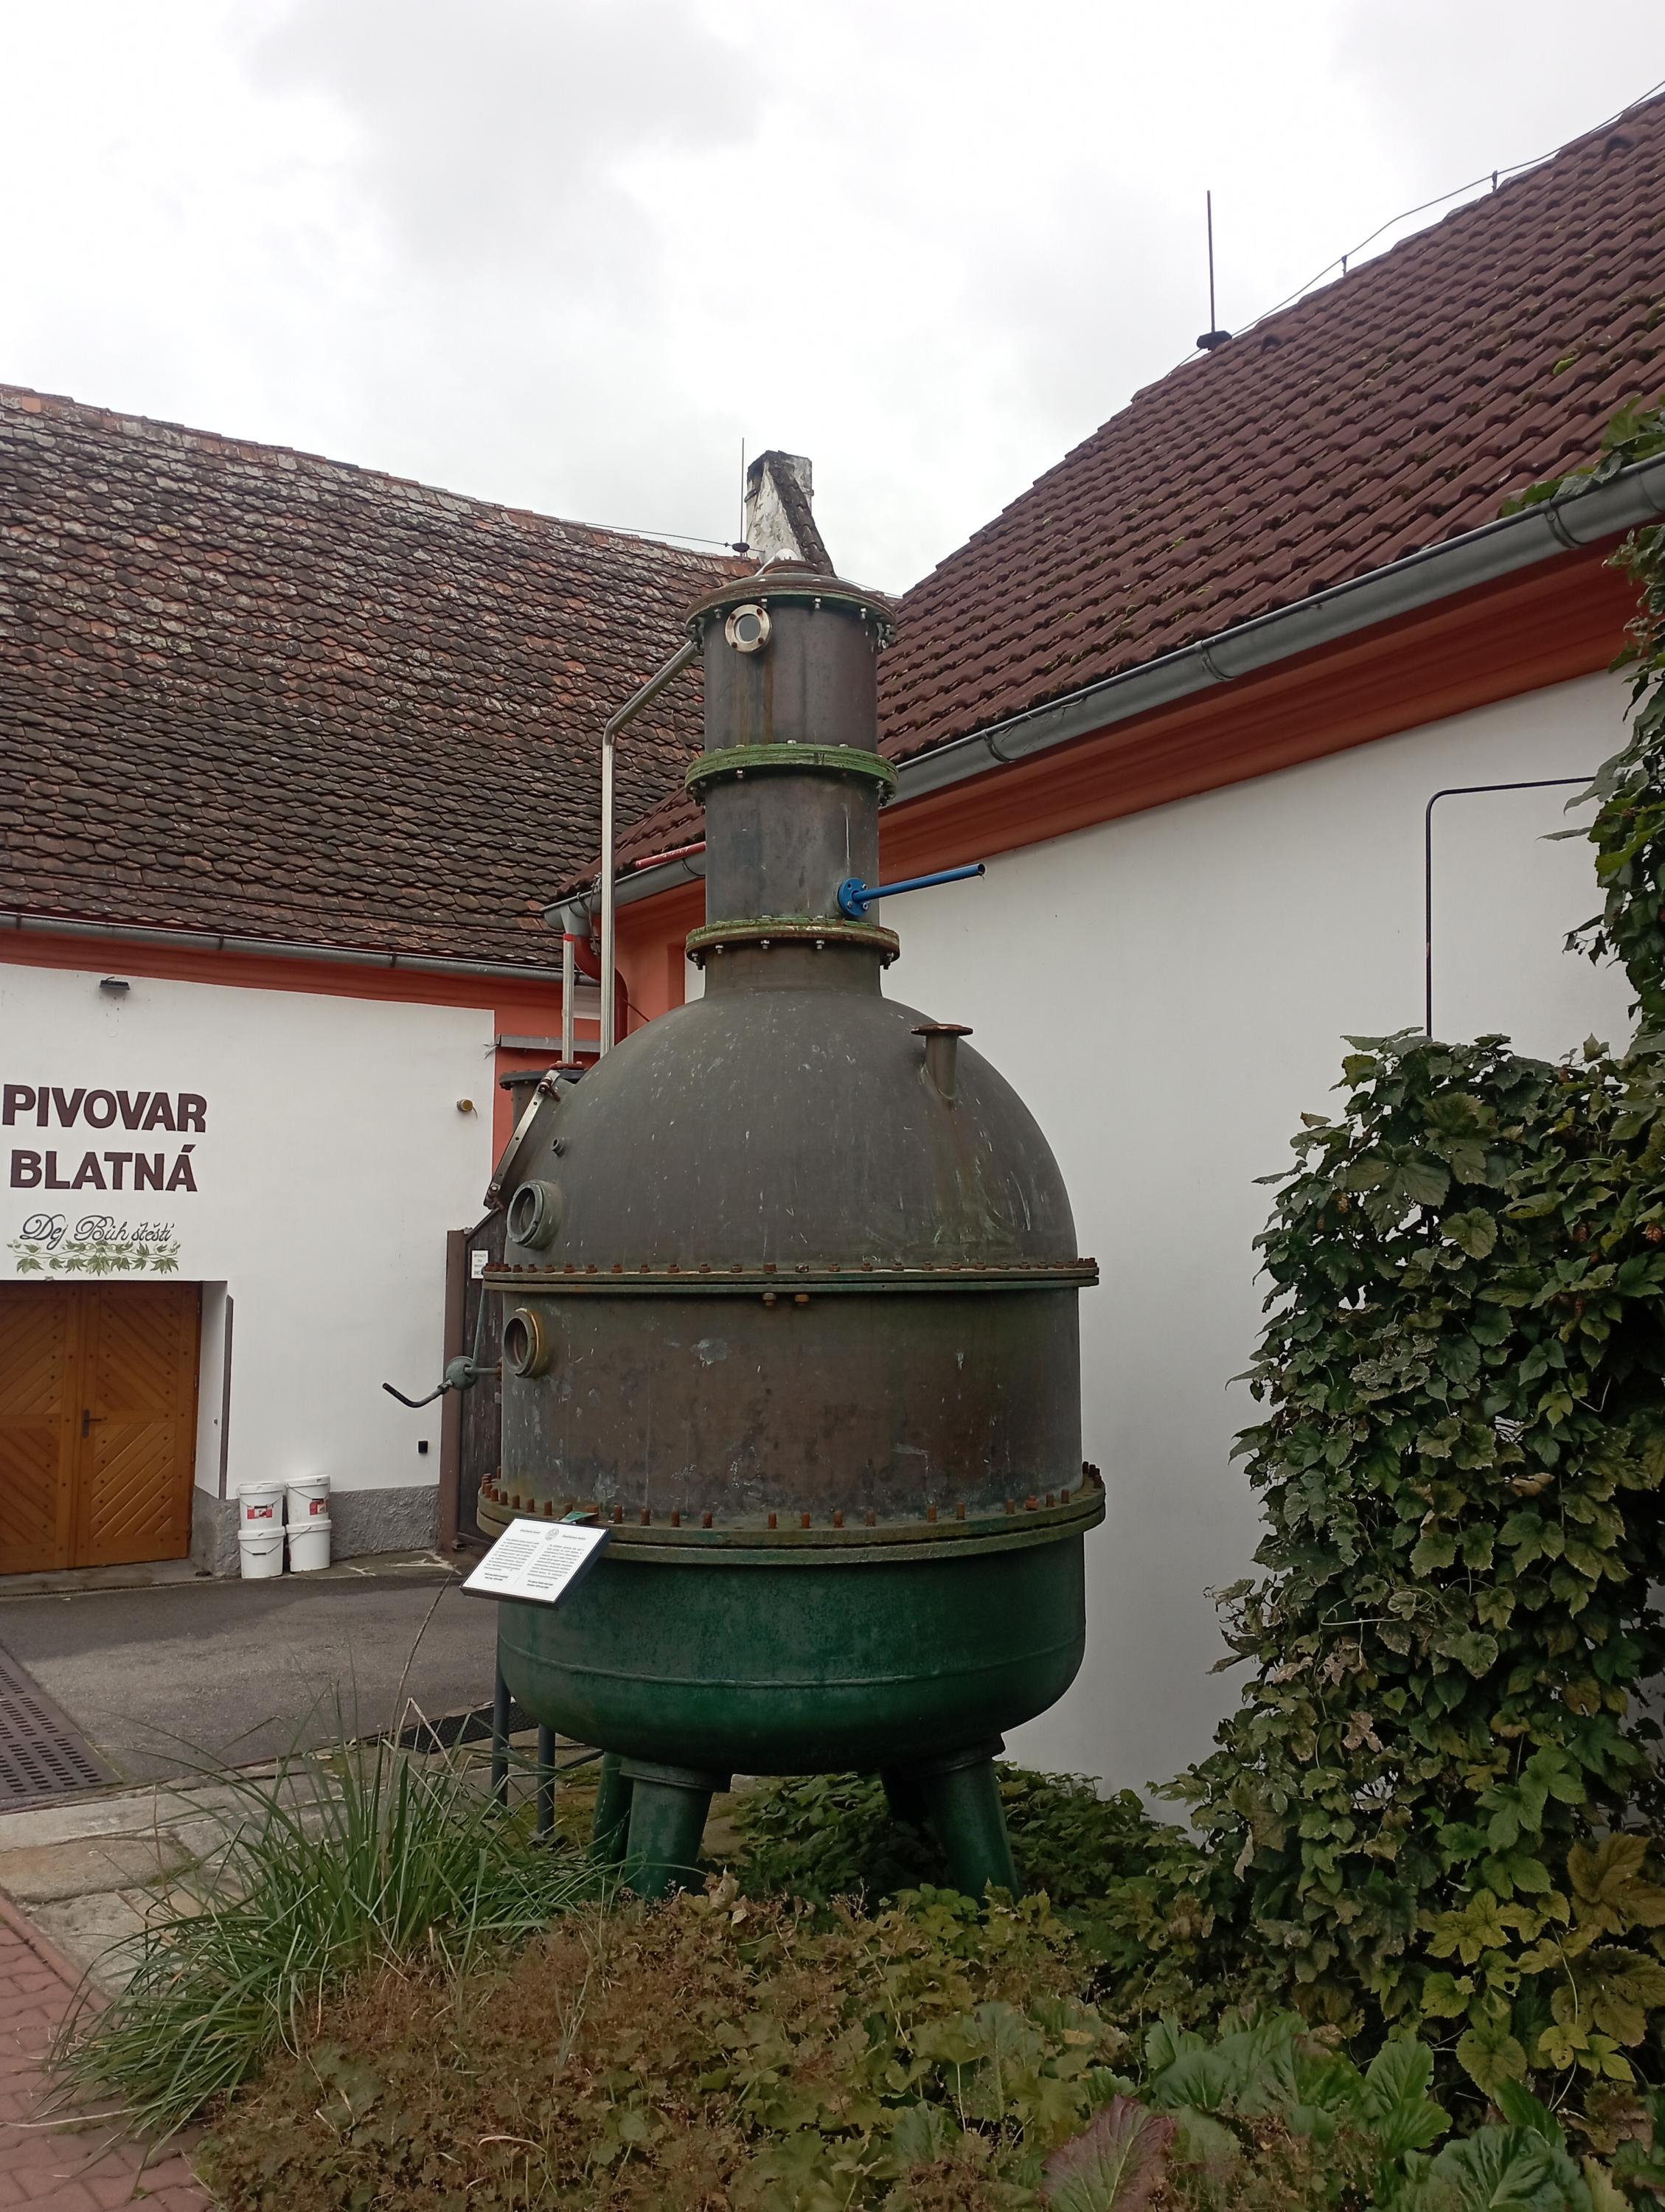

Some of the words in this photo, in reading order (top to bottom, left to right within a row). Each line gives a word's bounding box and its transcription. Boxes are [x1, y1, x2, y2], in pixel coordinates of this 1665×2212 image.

[2, 1084, 207, 1133] PIVOVAR
[10, 1144, 198, 1192] BLATNÁ
[19, 1214, 69, 1250] Dej
